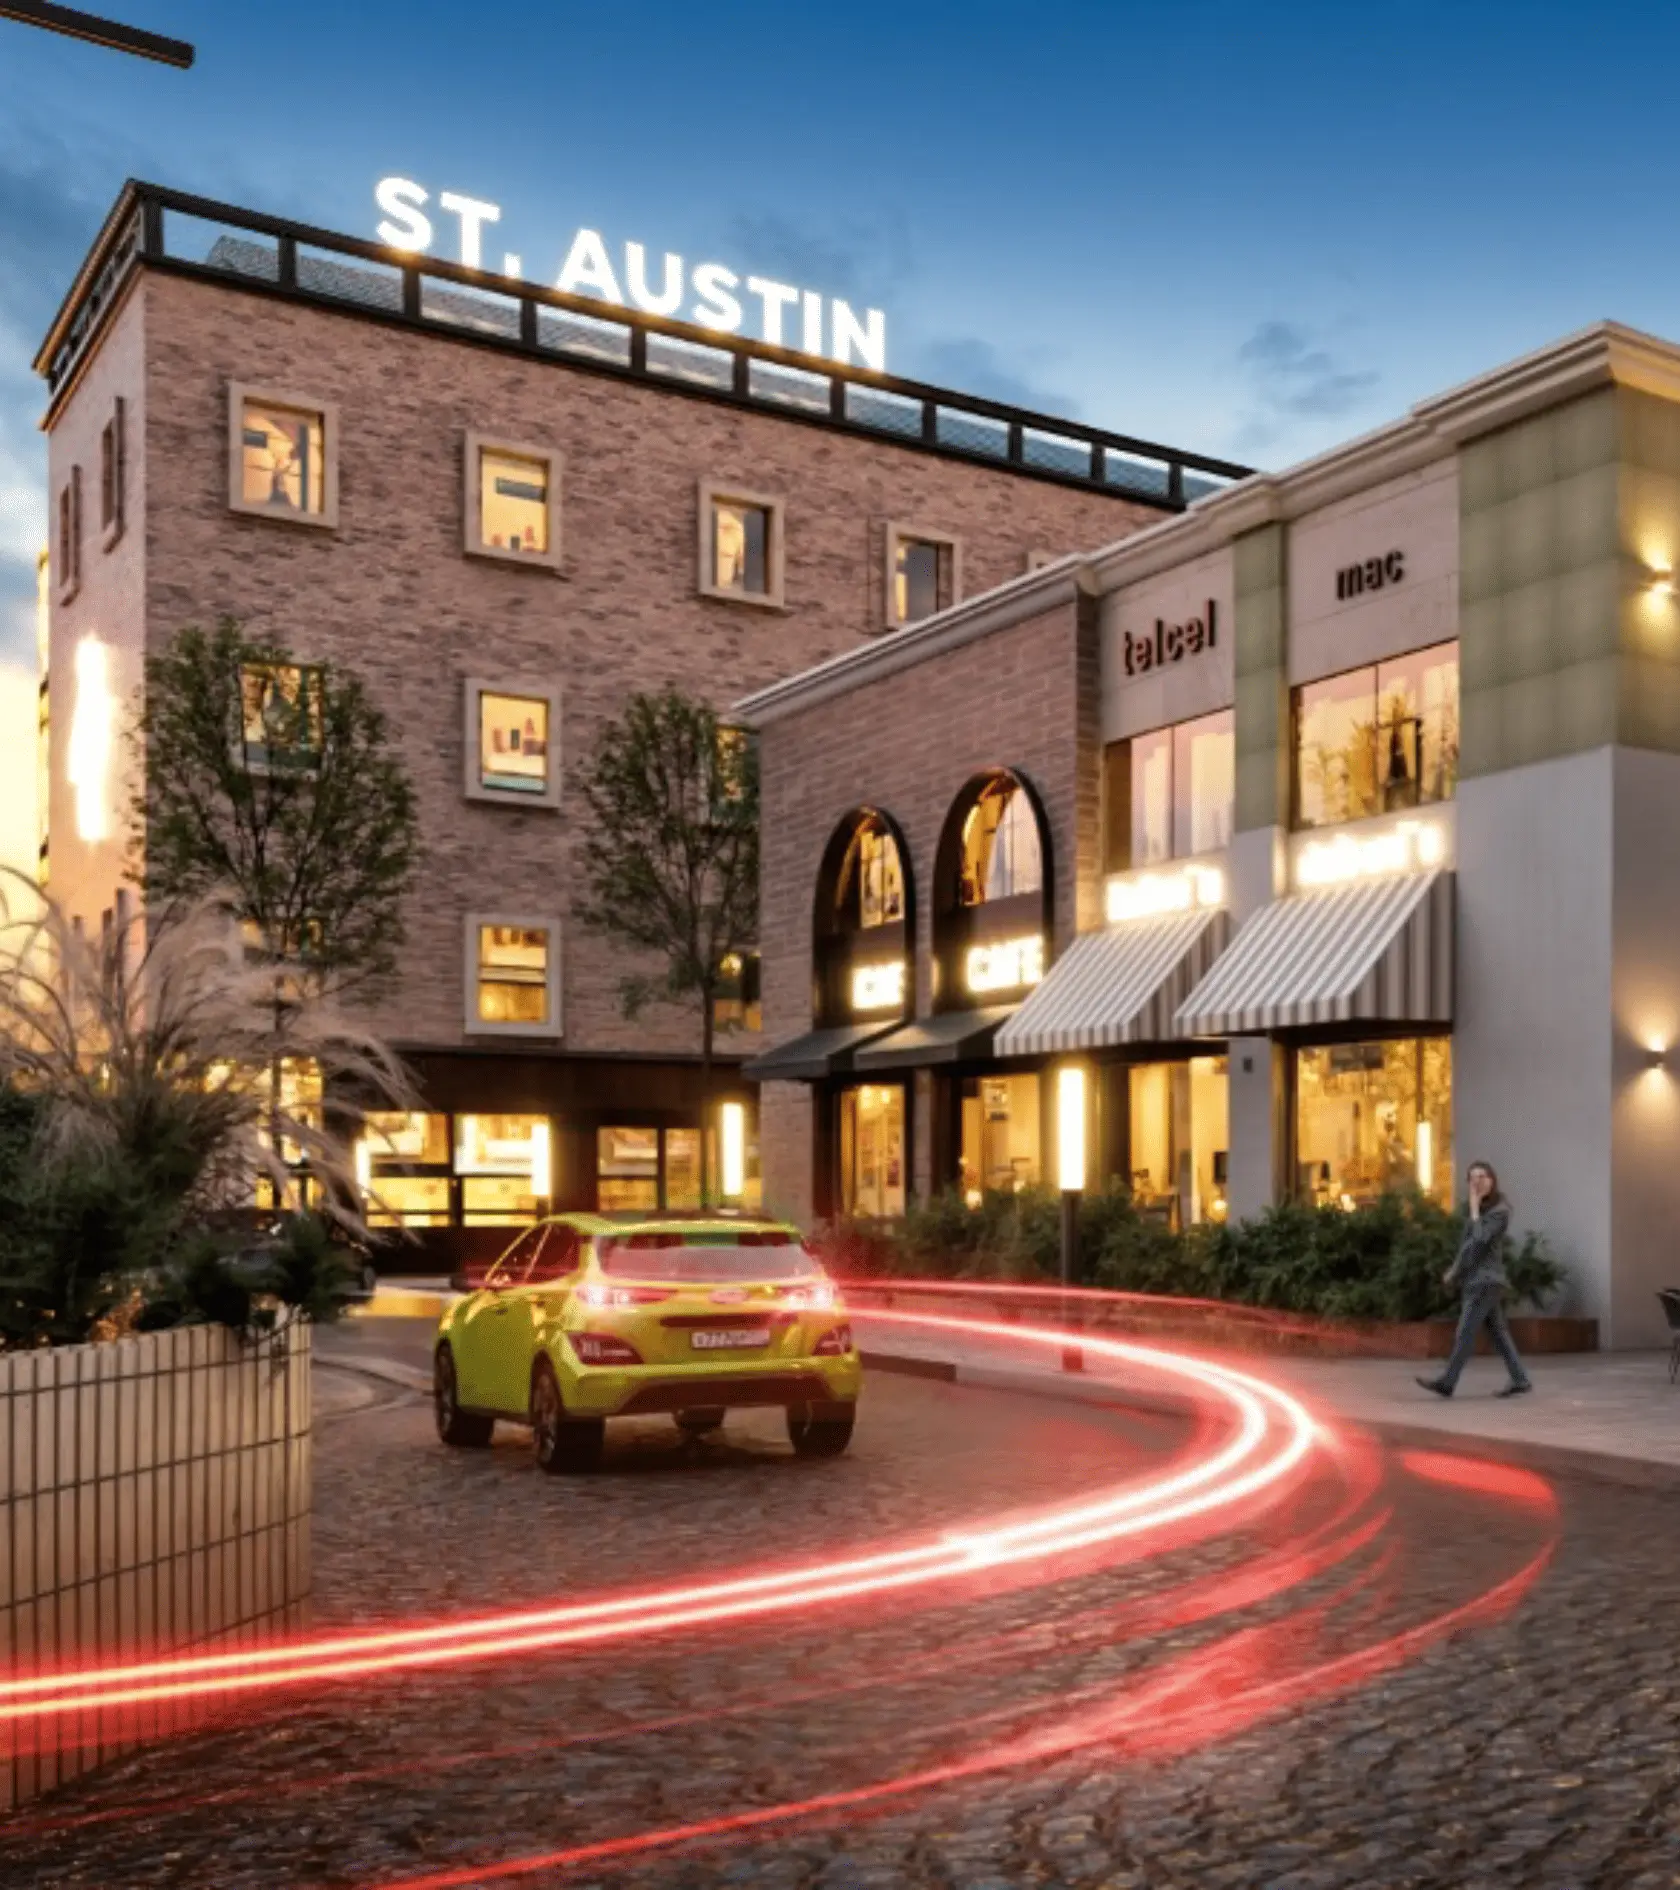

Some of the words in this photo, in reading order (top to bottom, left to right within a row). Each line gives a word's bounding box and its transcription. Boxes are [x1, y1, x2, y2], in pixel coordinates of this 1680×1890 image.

[557, 228, 886, 371] AUSTIN
[1336, 550, 1404, 600] mac
[1123, 599, 1215, 676] telcel
